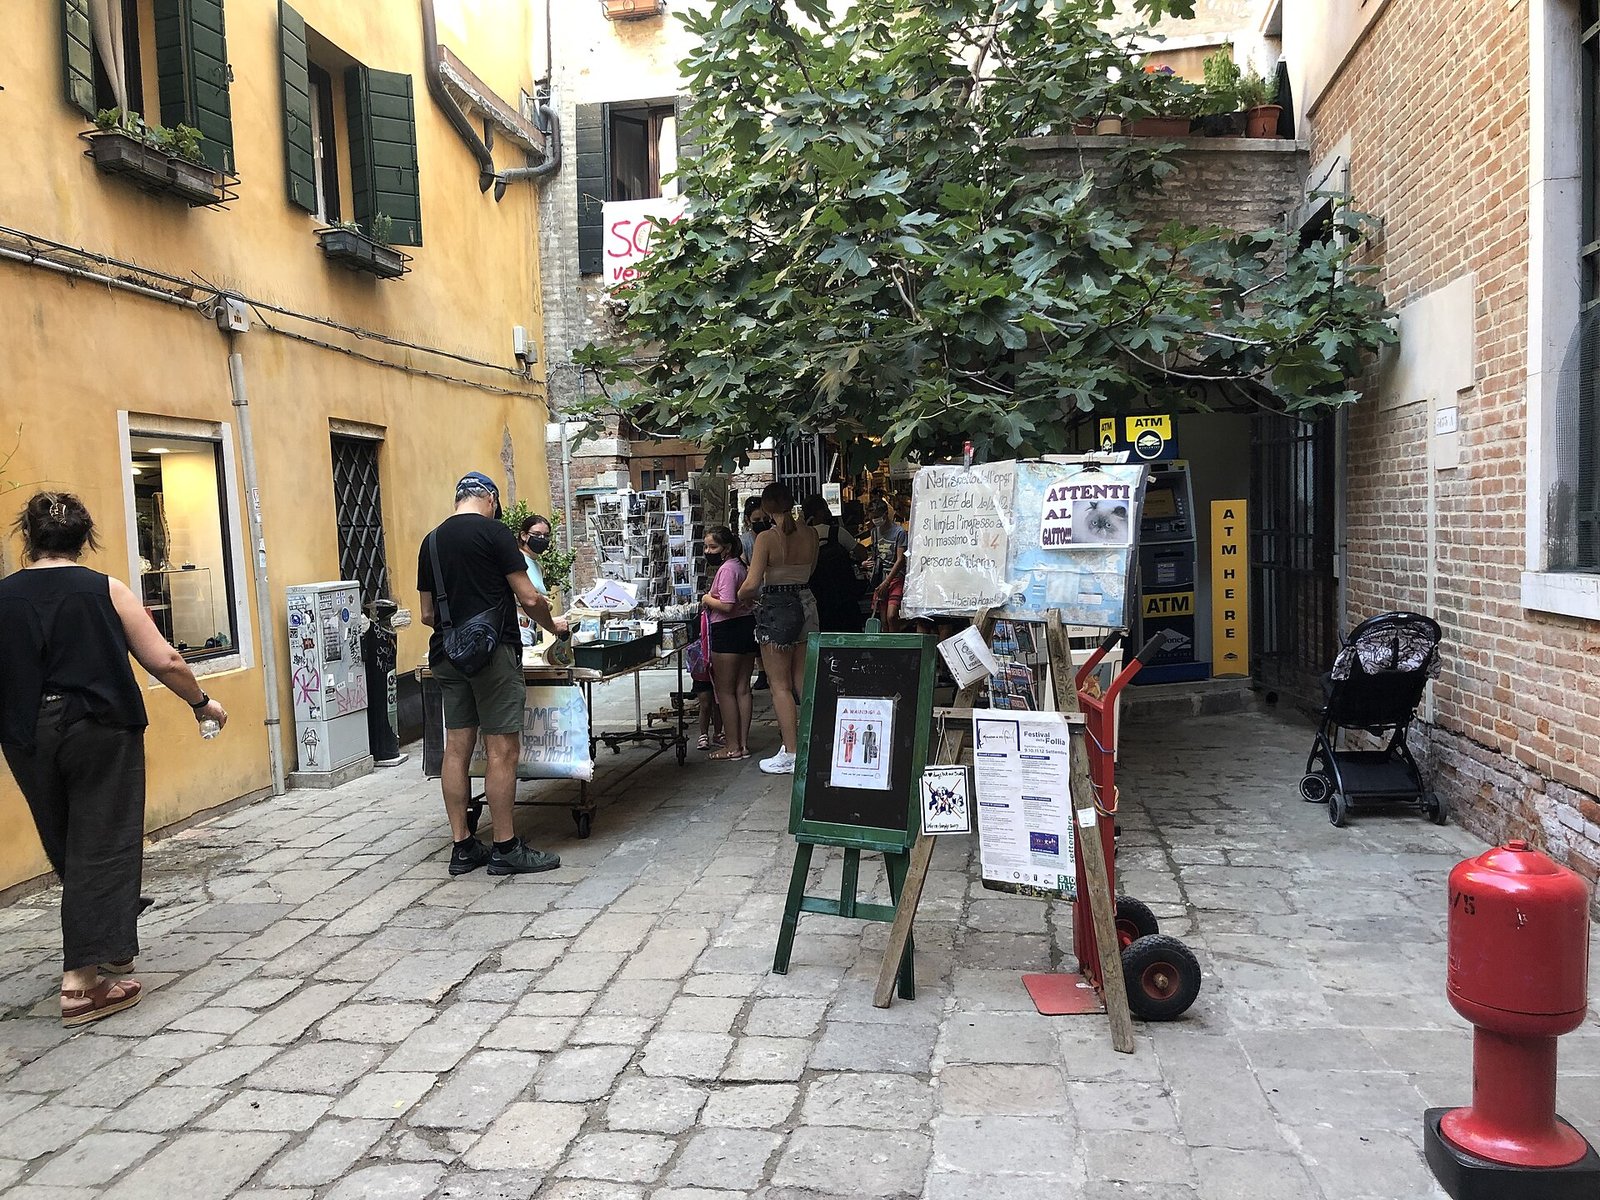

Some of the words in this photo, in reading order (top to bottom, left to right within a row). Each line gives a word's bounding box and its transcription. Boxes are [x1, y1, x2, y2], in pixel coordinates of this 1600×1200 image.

[1101, 422, 1113, 432] ATM
[1135, 418, 1162, 428] ATM
[960, 491, 974, 509] del
[1046, 484, 1130, 502] ATTENTI
[1045, 508, 1071, 520] AL
[934, 514, 955, 535] limita
[1222, 509, 1237, 555] ATM
[936, 534, 969, 547] massimo
[970, 531, 980, 546] di
[920, 555, 953, 573] persone
[1147, 595, 1189, 613] ATM
[1223, 569, 1236, 638] HERE
[522, 730, 568, 747] beautiful
[1024, 730, 1050, 738] Festival
[1045, 738, 1066, 746] Follia
[523, 745, 541, 762] the
[1067, 815, 1075, 864] settembre
